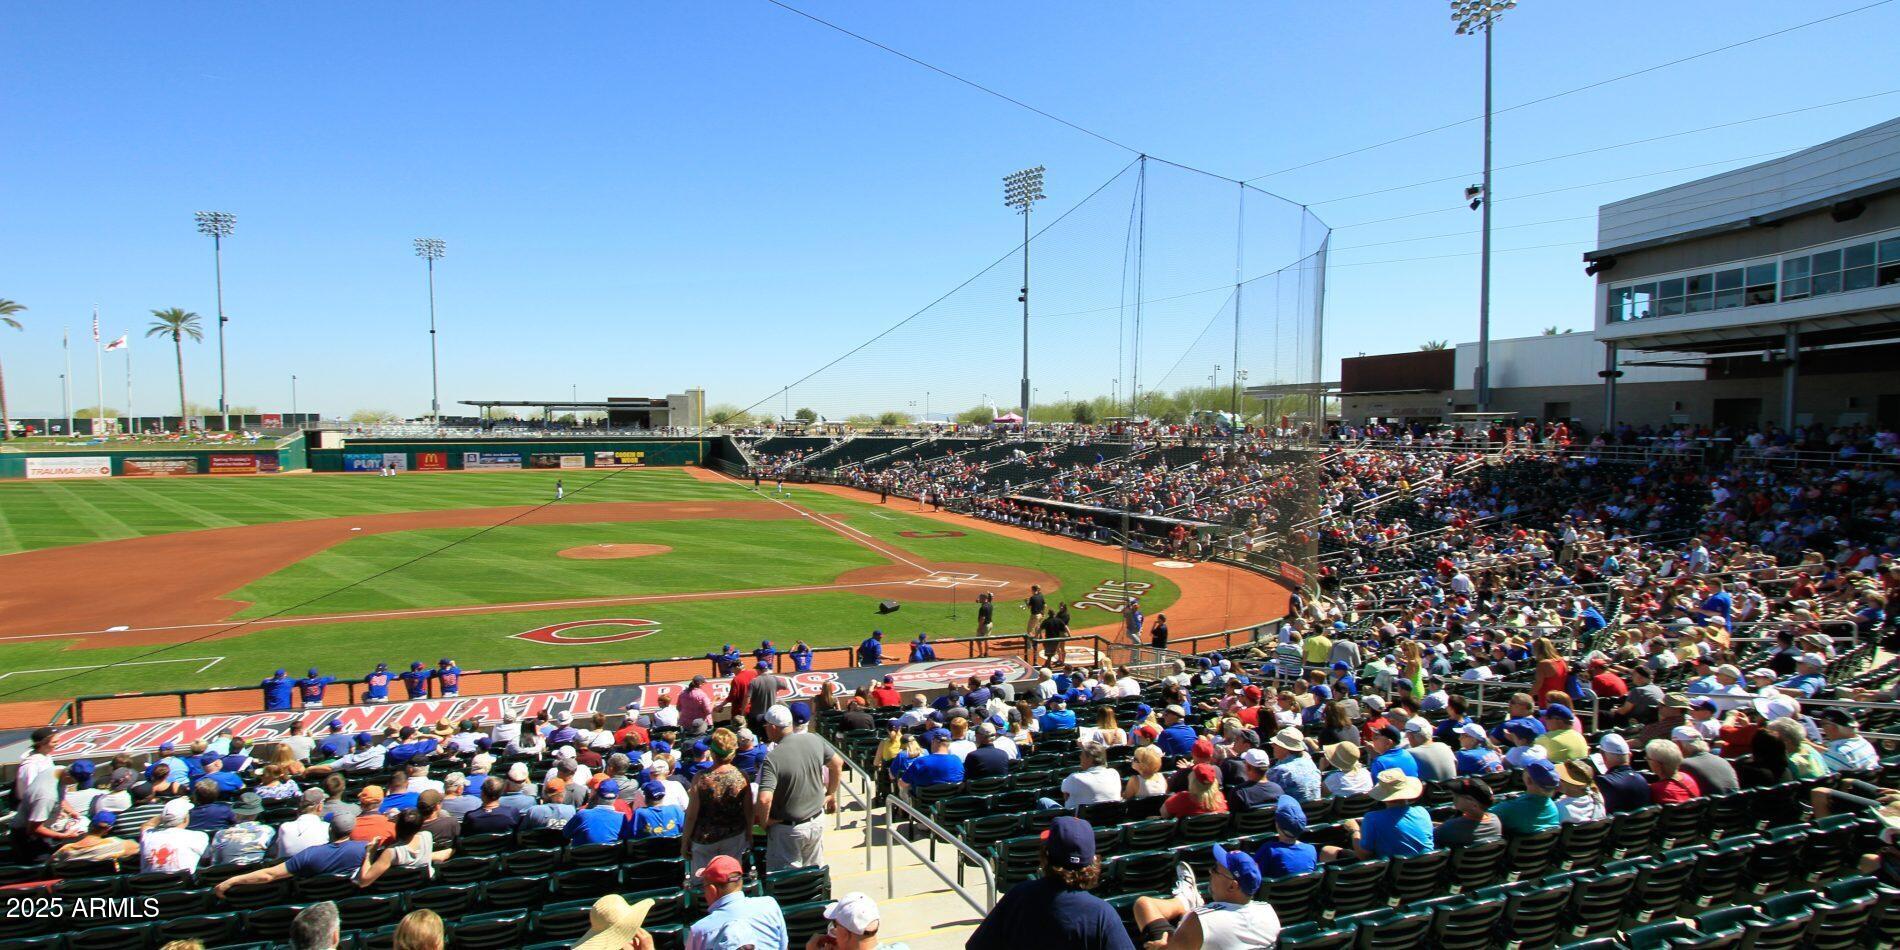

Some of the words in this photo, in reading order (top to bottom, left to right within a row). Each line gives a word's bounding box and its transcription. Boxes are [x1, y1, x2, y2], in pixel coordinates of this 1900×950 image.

[353, 459, 382, 469] PLAY
[1070, 579, 1154, 613] 2015
[51, 688, 605, 761] CINCINNATI
